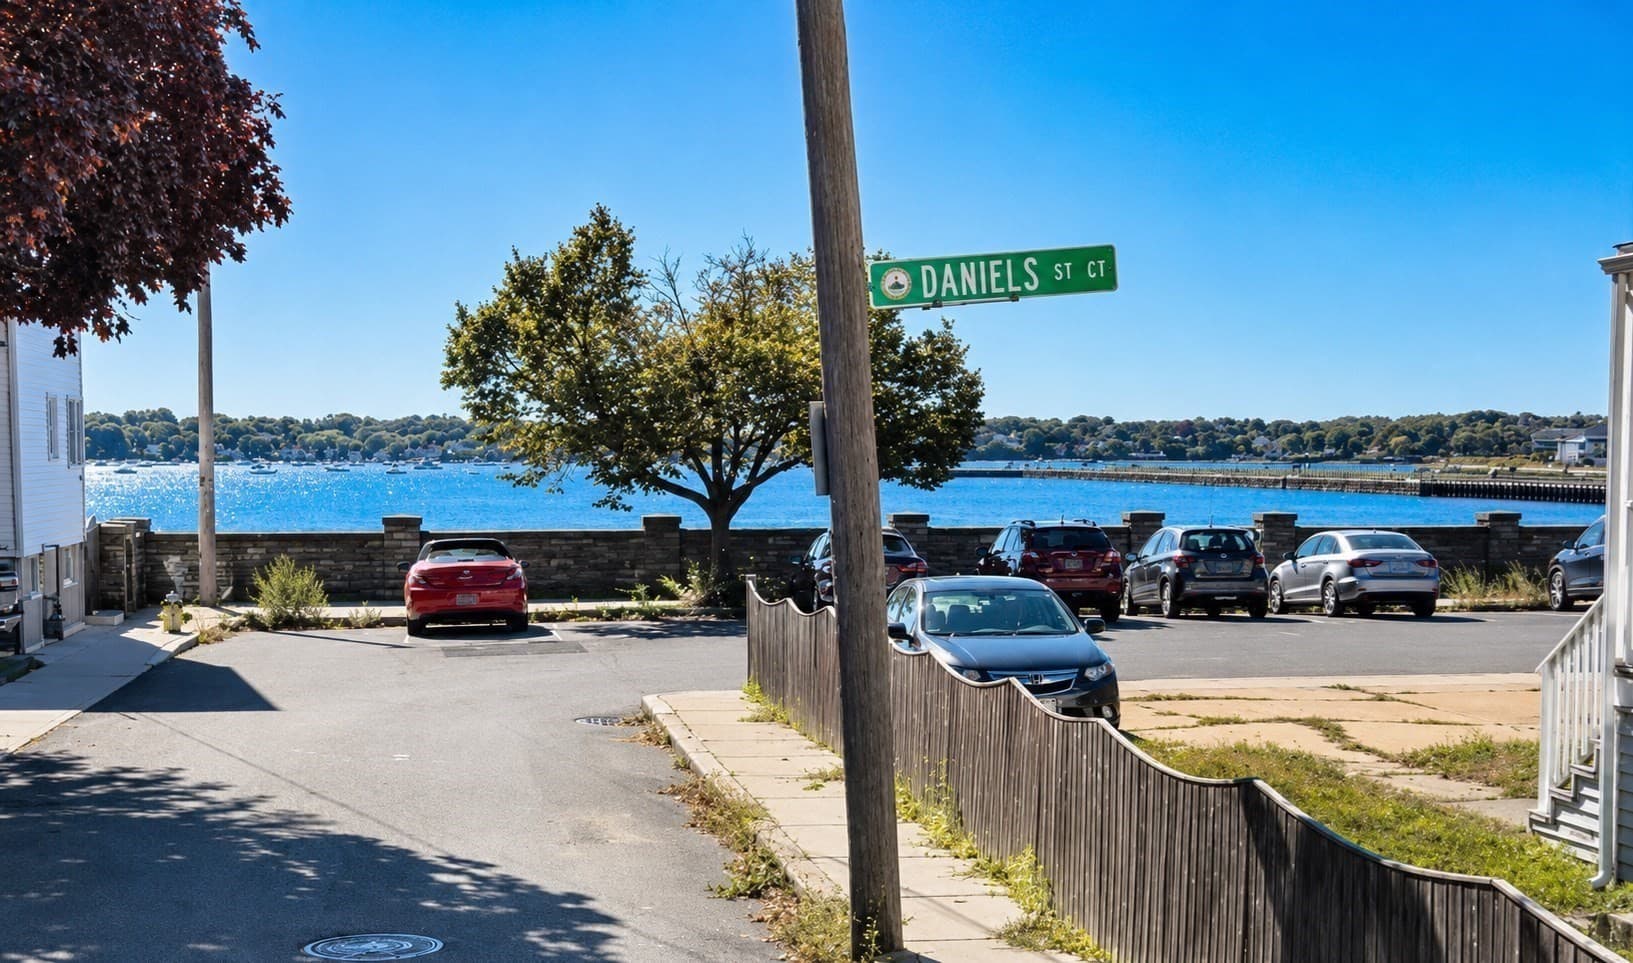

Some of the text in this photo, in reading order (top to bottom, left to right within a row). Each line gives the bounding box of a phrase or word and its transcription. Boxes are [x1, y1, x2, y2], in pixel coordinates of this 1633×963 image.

[921, 257, 1040, 298] DANIELS
[1054, 263, 1072, 281] ST
[1087, 260, 1106, 278] CT
